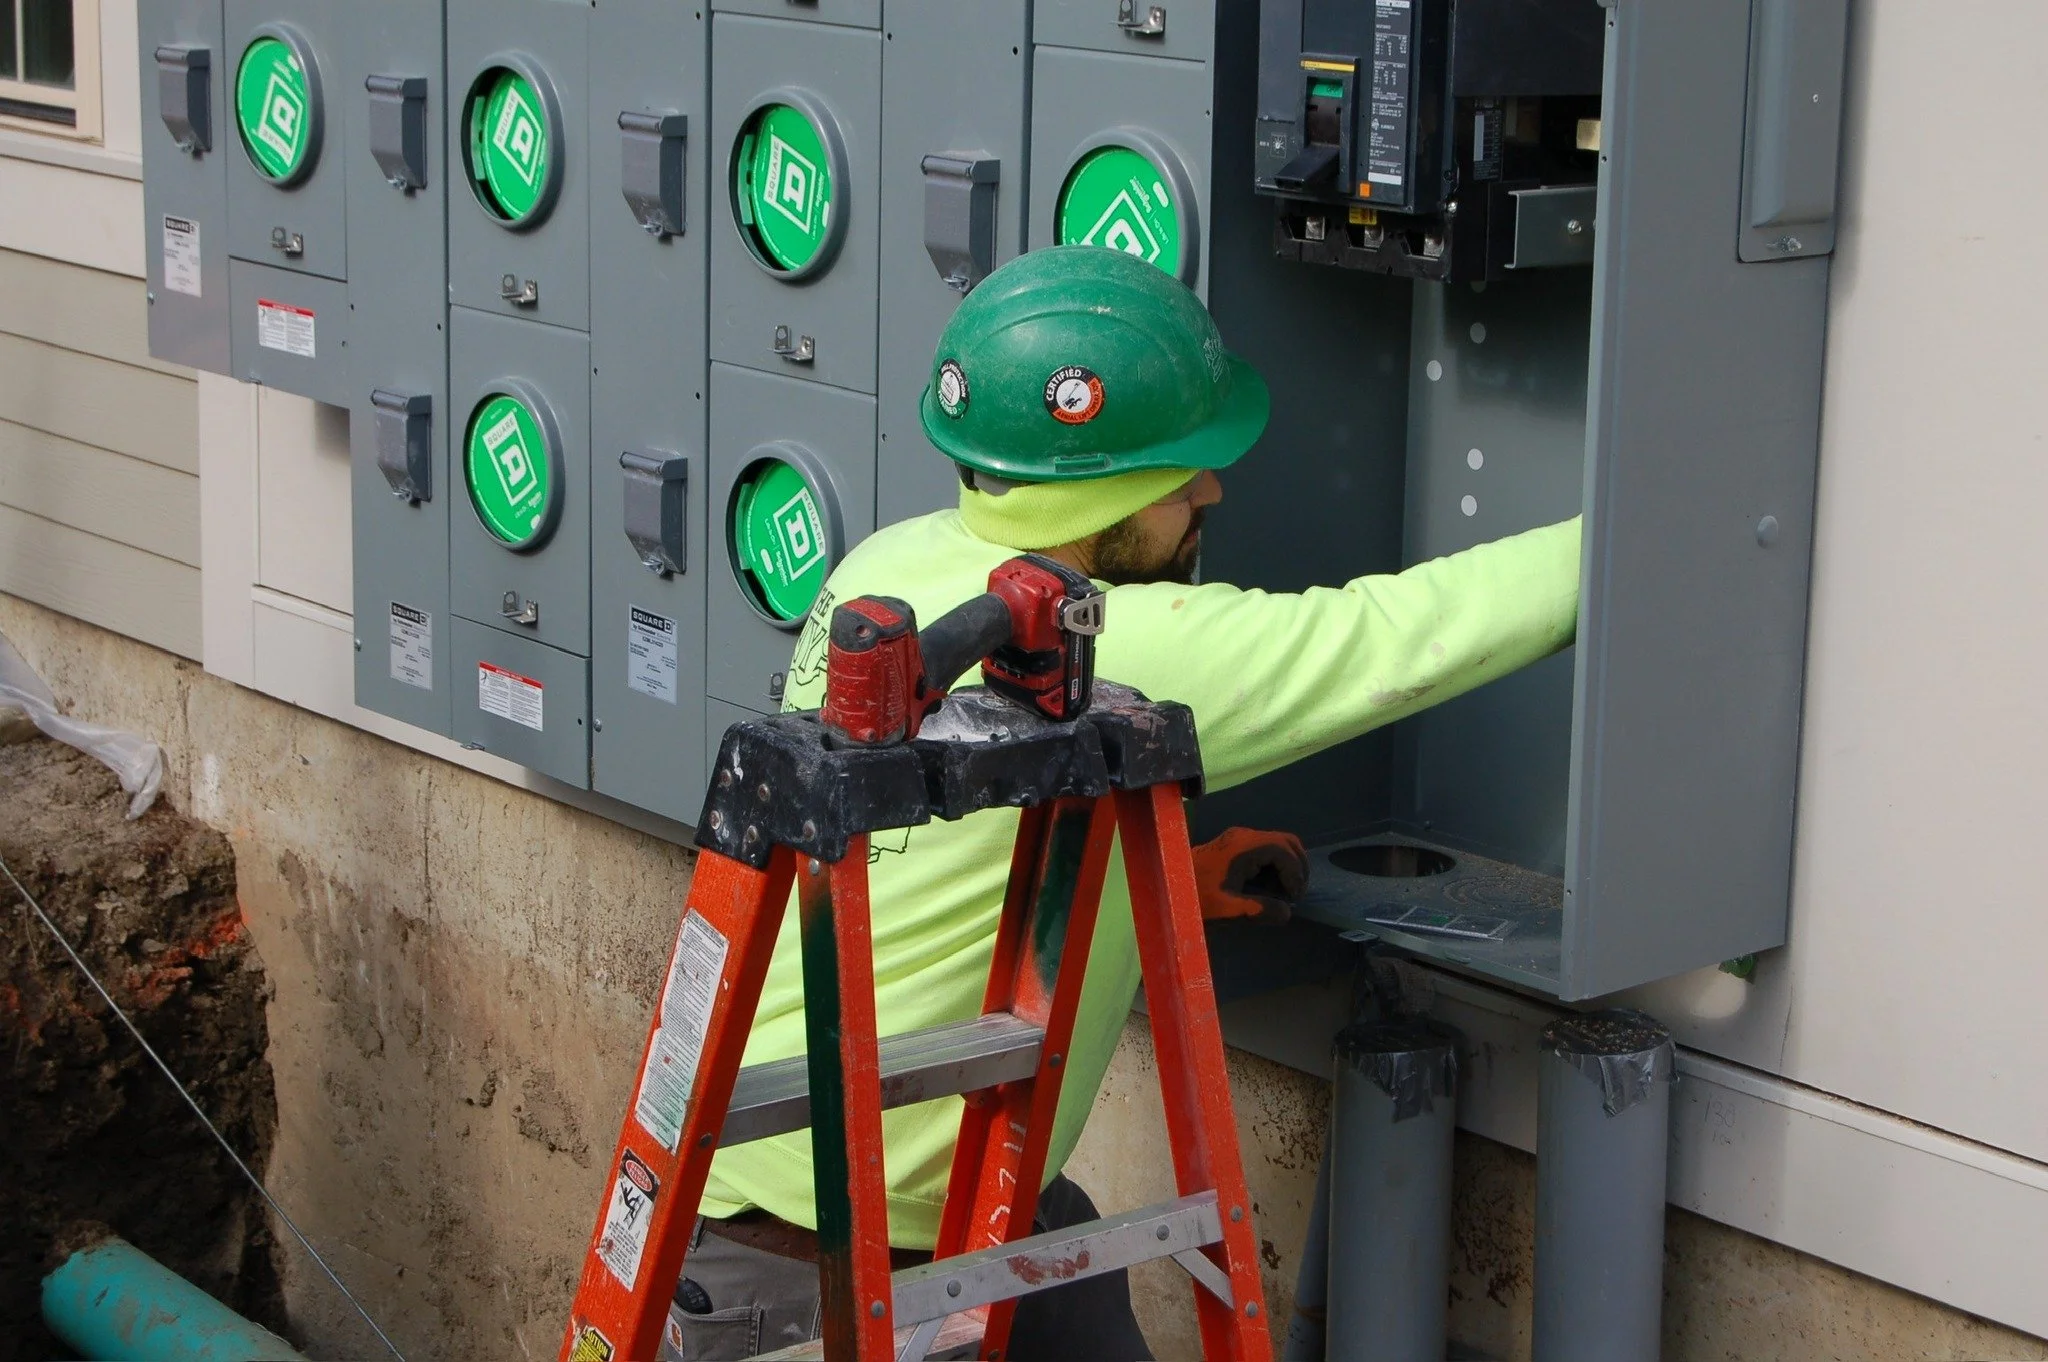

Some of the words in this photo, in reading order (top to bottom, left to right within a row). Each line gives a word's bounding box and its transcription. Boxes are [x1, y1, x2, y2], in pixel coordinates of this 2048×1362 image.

[497, 95, 517, 143] SQUARE
[511, 116, 533, 165] D
[767, 141, 780, 199] SQUARE
[783, 161, 806, 212] D
[1046, 368, 1082, 401] CERTIFIED
[487, 418, 514, 445] SQUARE
[500, 444, 526, 487] D
[785, 510, 811, 559] D
[803, 493, 825, 551] SQUARE
[393, 605, 419, 622] SQUARE
[632, 611, 663, 628] SQUARE
